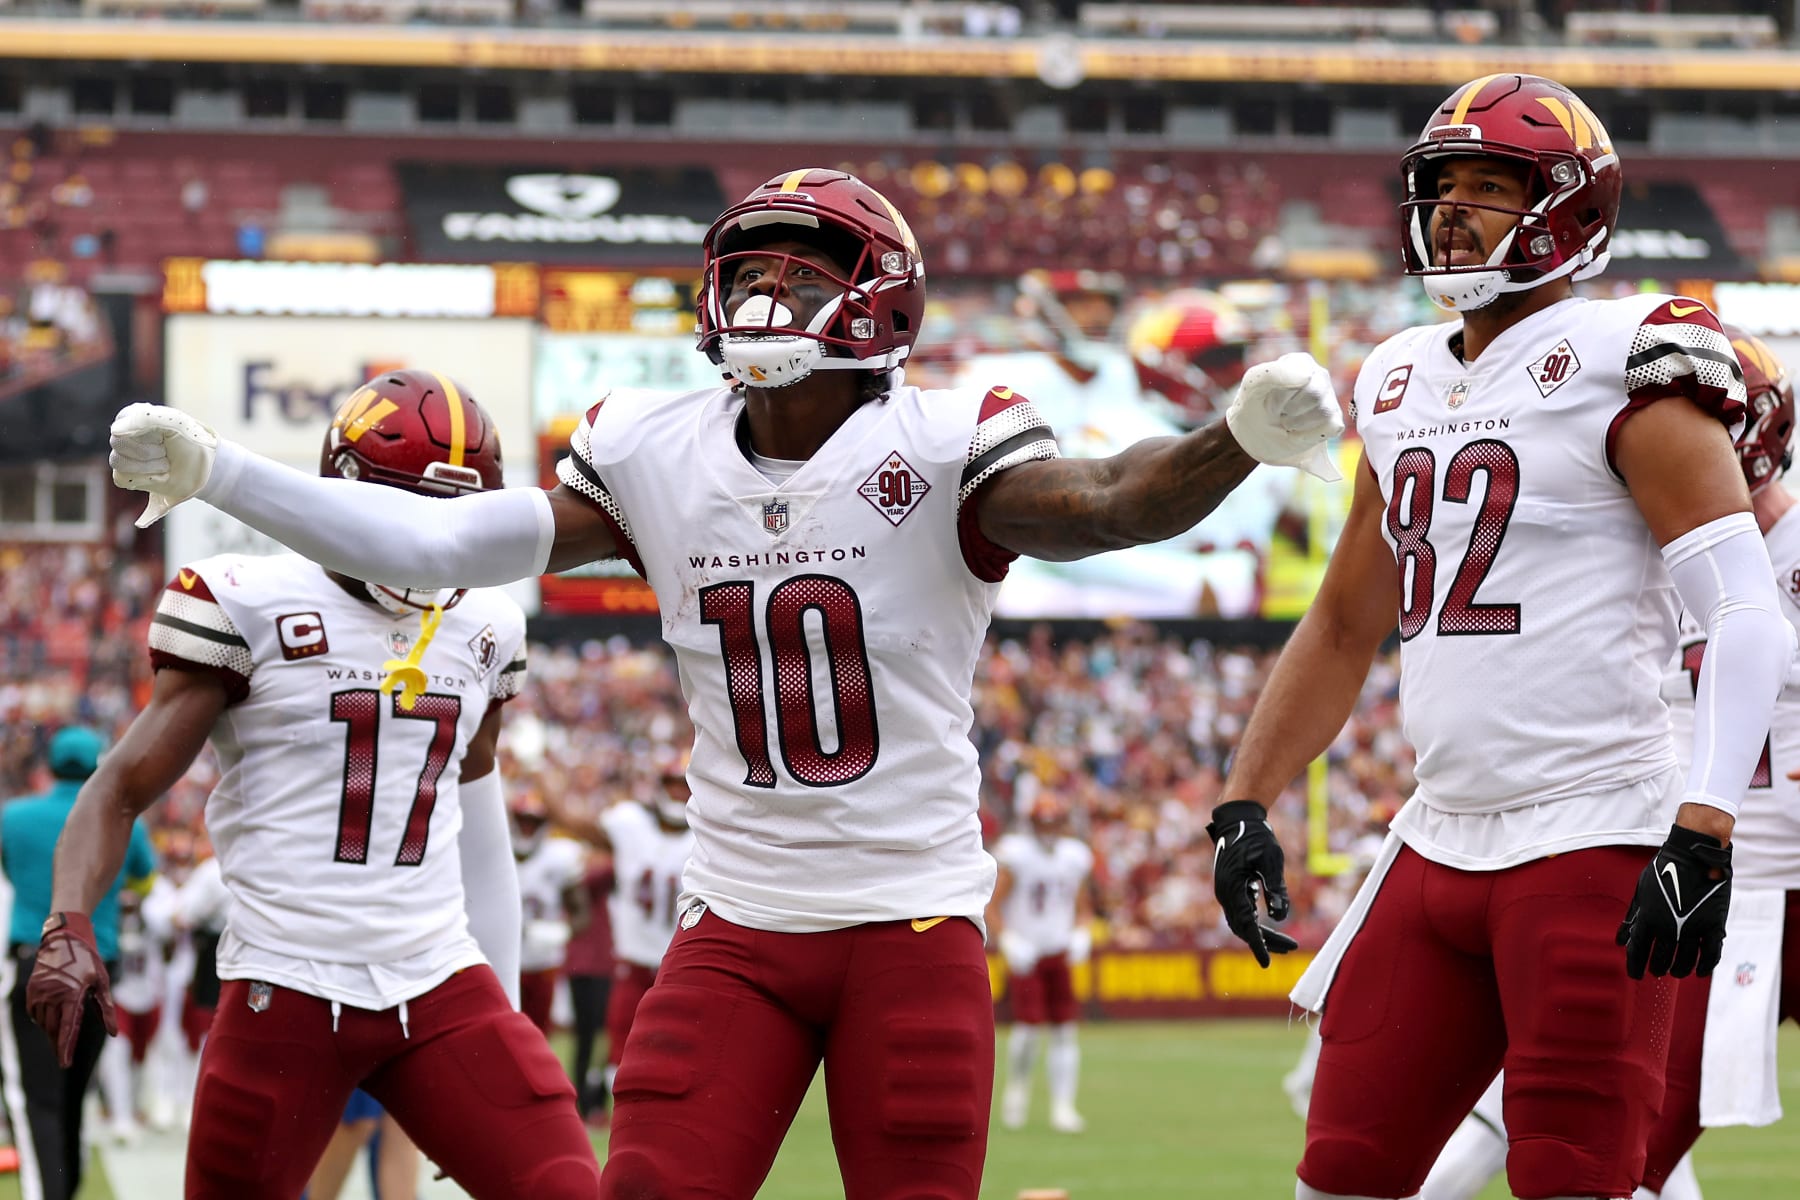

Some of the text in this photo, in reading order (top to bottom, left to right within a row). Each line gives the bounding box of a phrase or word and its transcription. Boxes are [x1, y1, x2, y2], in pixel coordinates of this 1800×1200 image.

[1379, 367, 1410, 402] C
[1540, 354, 1571, 382] 90
[1397, 418, 1510, 441] WASHINGTON
[878, 469, 912, 508] 90
[767, 513, 786, 529] NFL
[886, 508, 905, 516] YEARS
[689, 545, 867, 569] WASHINGTON
[1387, 438, 1521, 643] 82
[281, 613, 324, 649] C
[479, 636, 495, 669] 90
[327, 669, 467, 688] WASHTON
[698, 573, 880, 789] 10
[330, 688, 461, 867] 17
